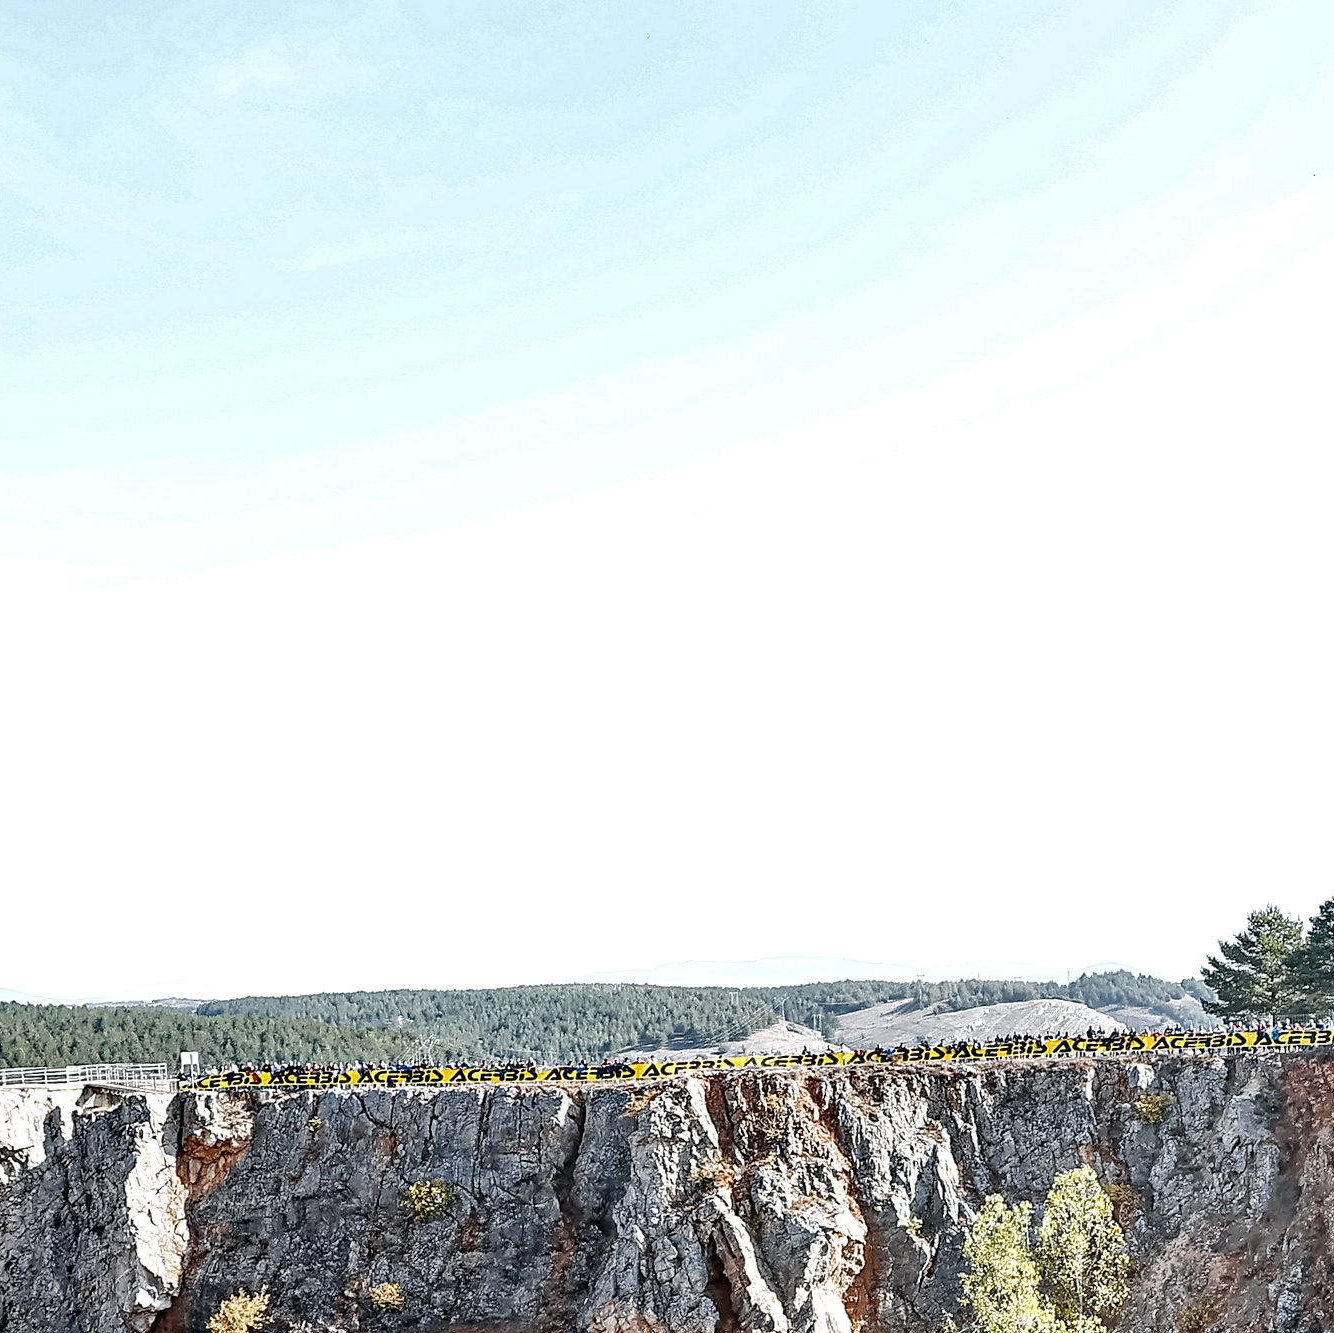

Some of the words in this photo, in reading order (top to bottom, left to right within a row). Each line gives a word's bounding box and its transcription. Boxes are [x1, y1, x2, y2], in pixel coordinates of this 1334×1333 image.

[1053, 1037, 1149, 1053] ACERBIS
[1151, 1033, 1248, 1052] ACERBIS
[269, 1071, 352, 1084] ACERBIS
[358, 1070, 444, 1083] ACERBIS
[450, 1069, 538, 1082] ACERBIS
